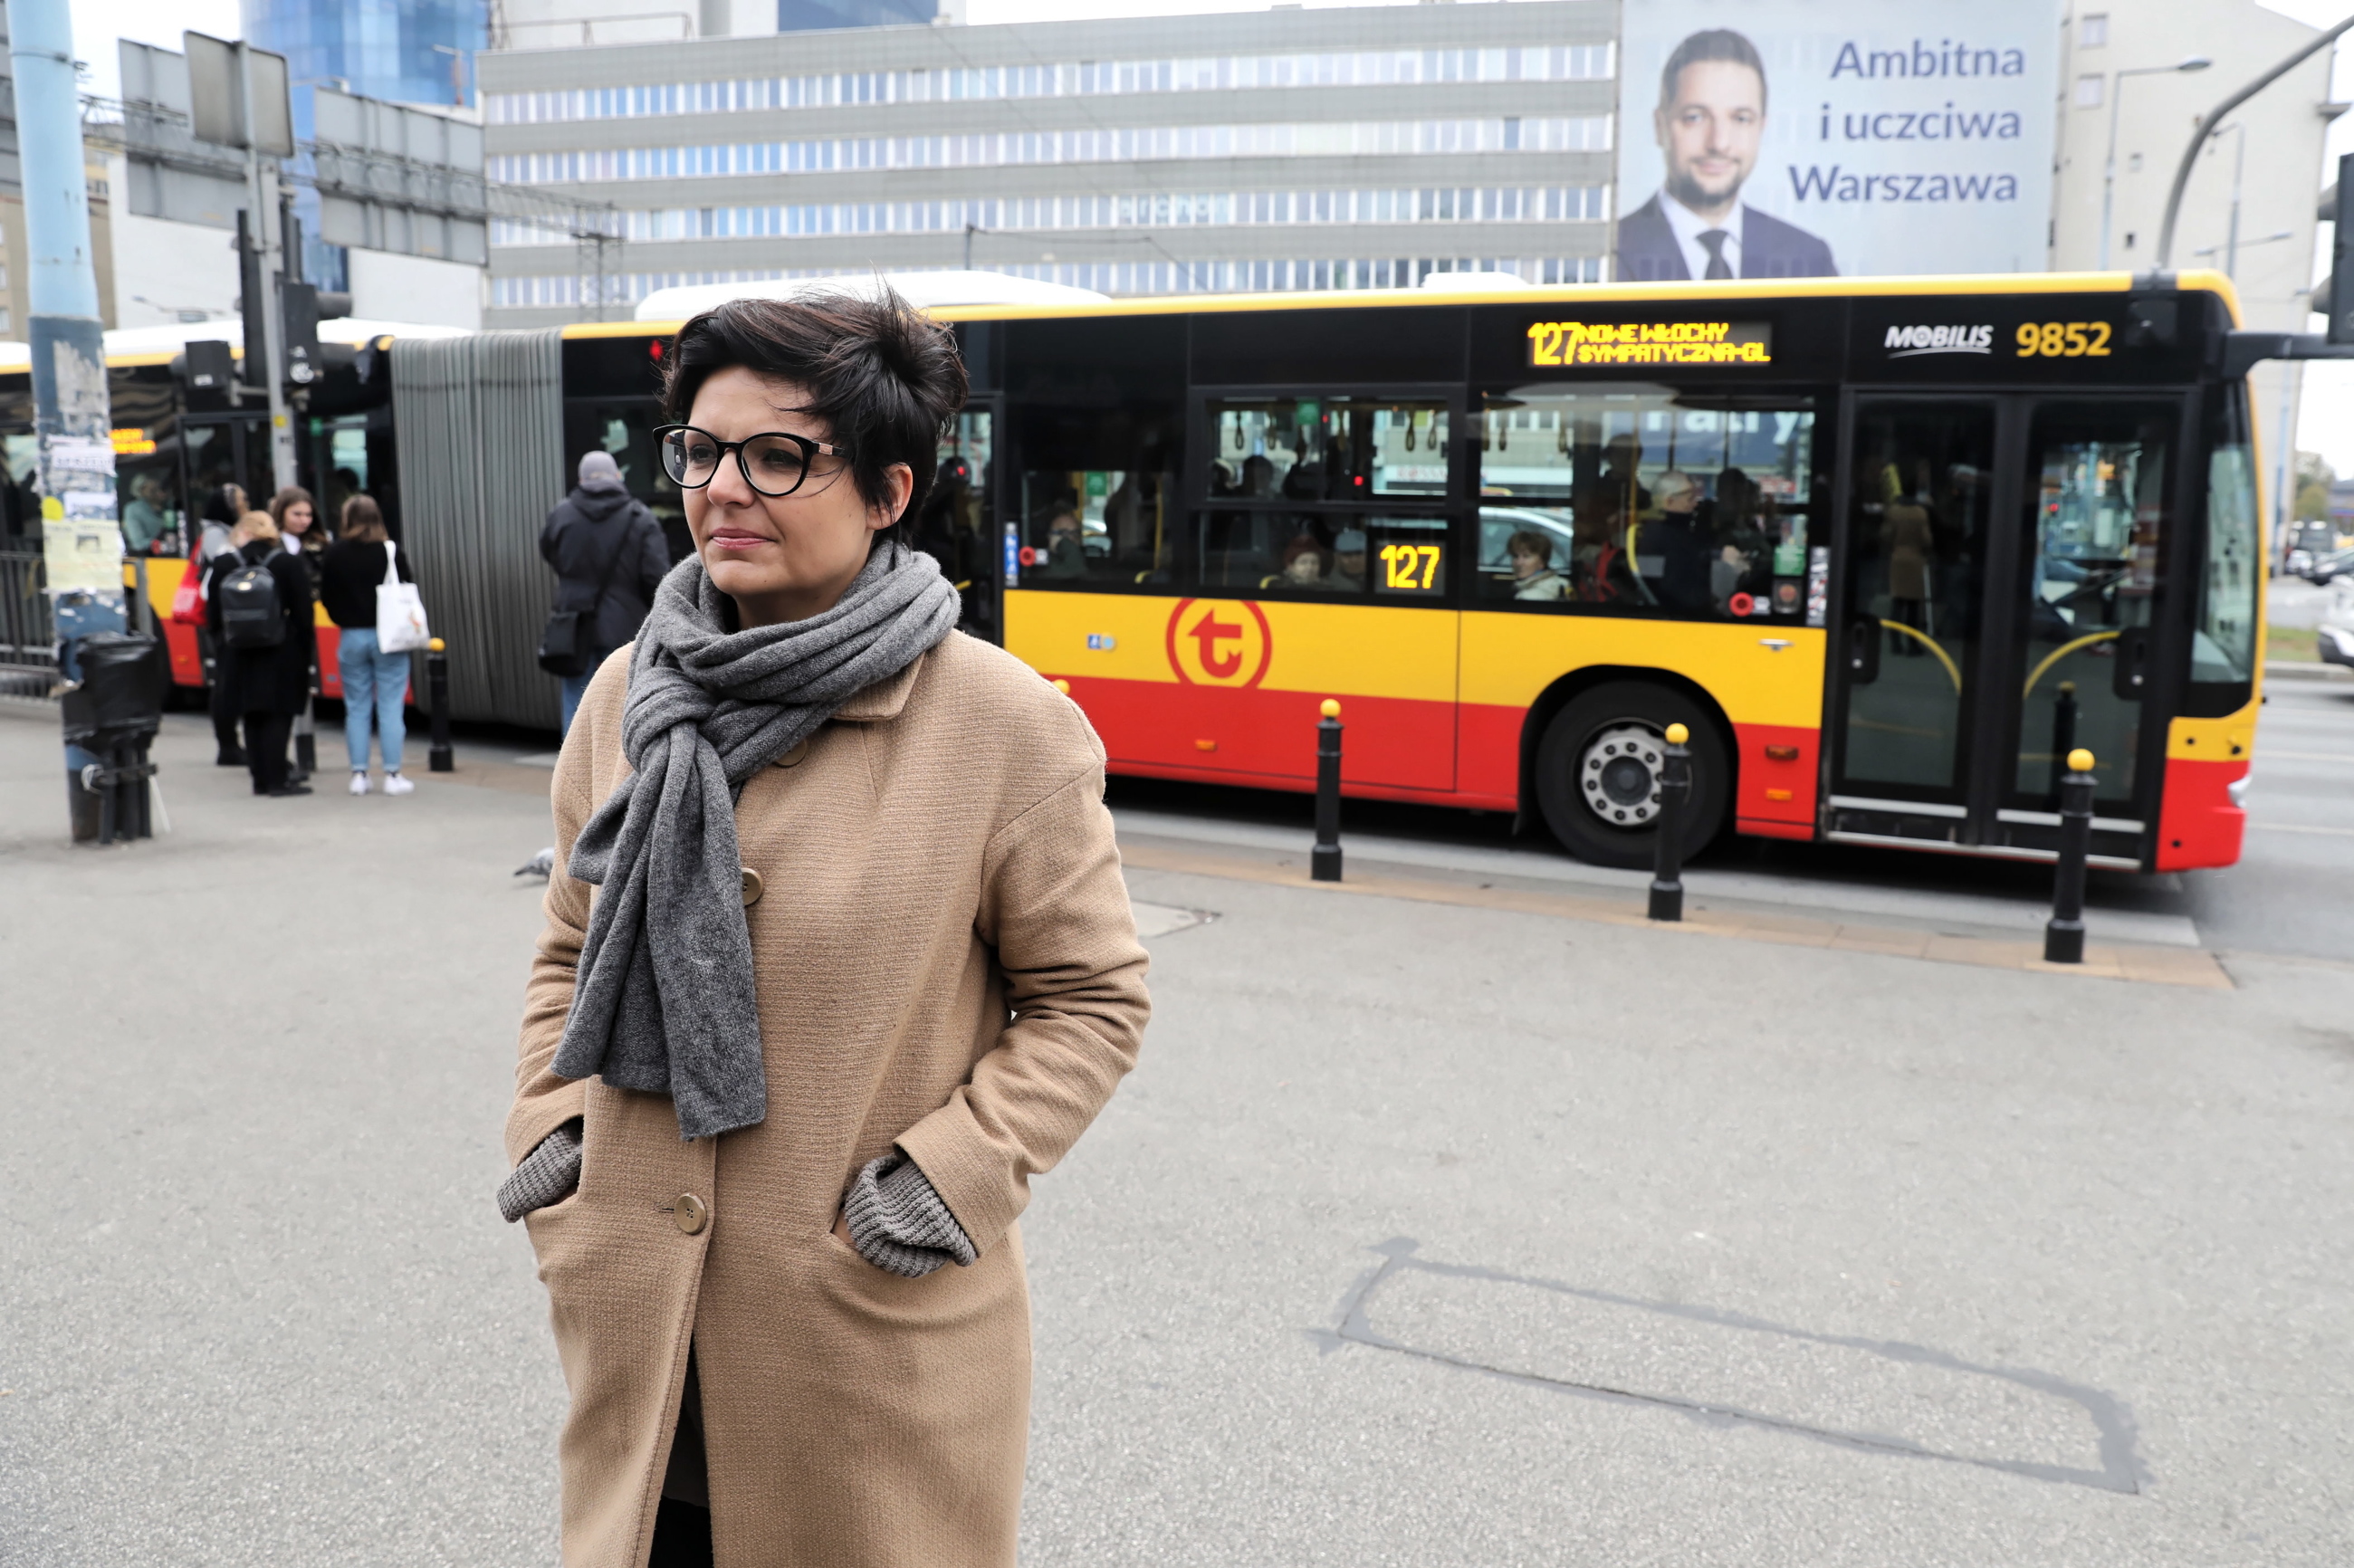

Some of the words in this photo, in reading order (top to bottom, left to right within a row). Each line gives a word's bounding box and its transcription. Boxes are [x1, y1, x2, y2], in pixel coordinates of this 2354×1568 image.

[1830, 39, 2024, 79] Ambitna
[1820, 101, 1831, 140] i
[1843, 101, 2022, 140] uczciwa
[1787, 165, 2017, 202] Warszawa
[1527, 322, 1582, 365] 127
[1579, 324, 1639, 343] NOWE
[1884, 325, 1994, 348] MOBILIS
[2015, 321, 2111, 357] 9852
[1380, 544, 1440, 589] 127
